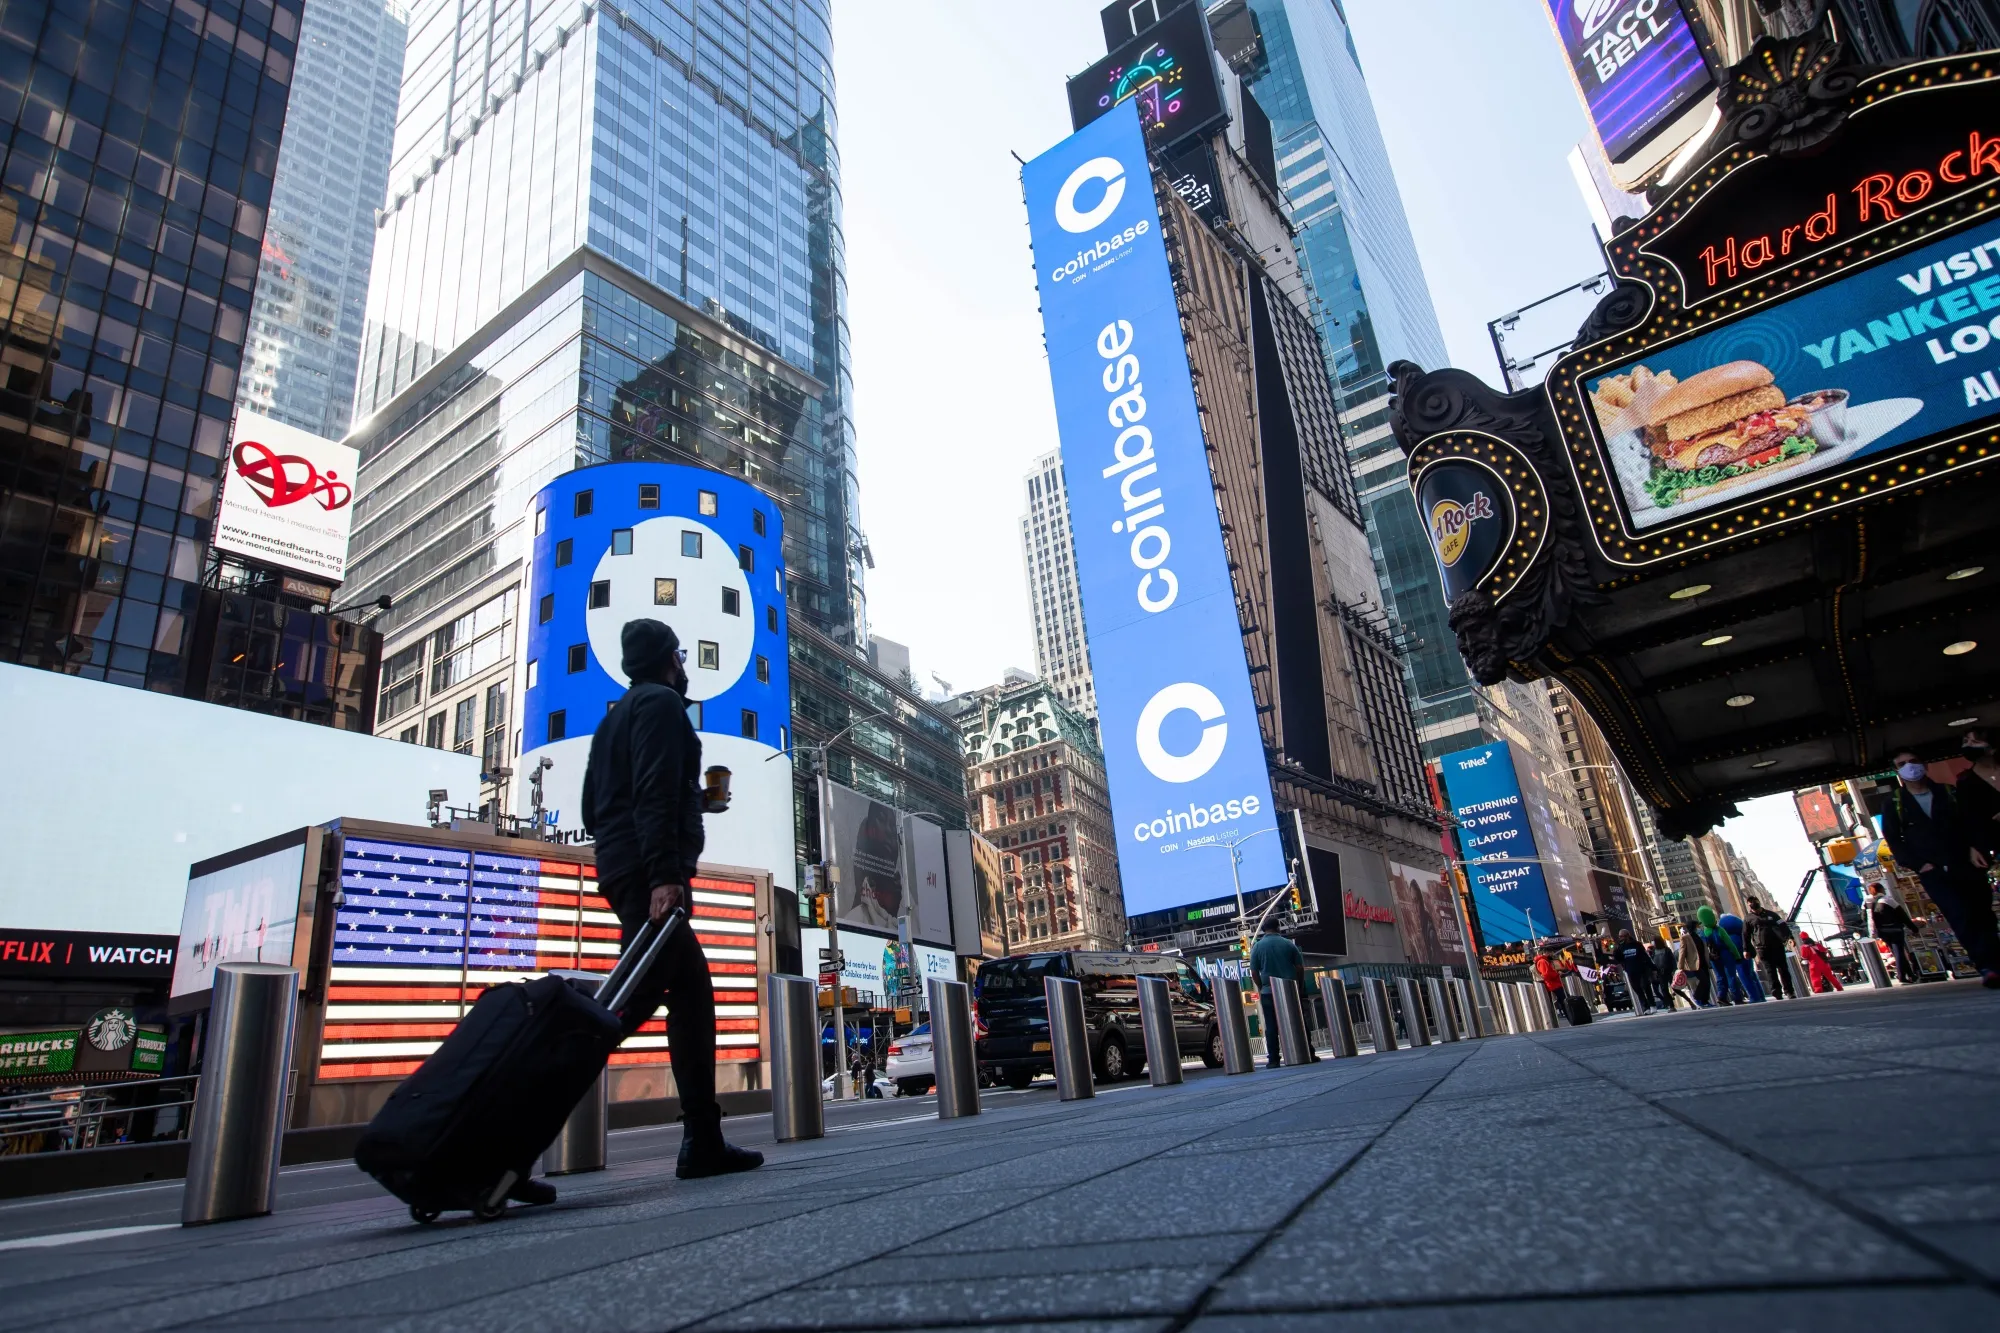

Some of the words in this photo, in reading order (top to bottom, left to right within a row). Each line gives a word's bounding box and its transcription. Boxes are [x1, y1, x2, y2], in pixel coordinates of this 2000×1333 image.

[1583, 0, 1659, 66] TACO
[1595, 15, 1669, 84] BELL
[1699, 193, 1837, 287] Hard
[1850, 131, 2000, 223] Rock
[1052, 219, 1150, 282] coinbase
[1072, 273, 1087, 285] COIN
[1092, 257, 1115, 273] Nasdaq
[1802, 273, 2000, 370] YANKEE
[1096, 318, 1179, 613] coinbase
[223, 499, 259, 515] Mended
[259, 509, 286, 523] Hearts
[1443, 492, 1493, 535] Rock
[222, 523, 343, 565] www.mendedhearts.org
[1443, 538, 1459, 557] CAFE
[286, 581, 327, 599] Absen
[1458, 757, 1487, 770] TriNet
[1458, 795, 1518, 816] RETURNING
[1133, 795, 1261, 843] coinbase
[1460, 819, 1476, 829] TO
[1477, 810, 1512, 826] WORK
[1160, 842, 1179, 854] COIN
[1187, 834, 1216, 848] Nasdaq
[1216, 828, 1239, 841] Listed
[1477, 829, 1518, 846] LAPTOP
[1481, 851, 1509, 862] KEYS
[1486, 866, 1531, 882] HAZMAT
[1489, 880, 1519, 894] SUIT?
[88, 946, 173, 965] WATCH
[868, 963, 877, 971] bus
[1196, 956, 1218, 979] NEW
[1216, 958, 1240, 980] YORK
[136, 1037, 167, 1051] STARBUCKS
[139, 1052, 159, 1064] COFFEE
